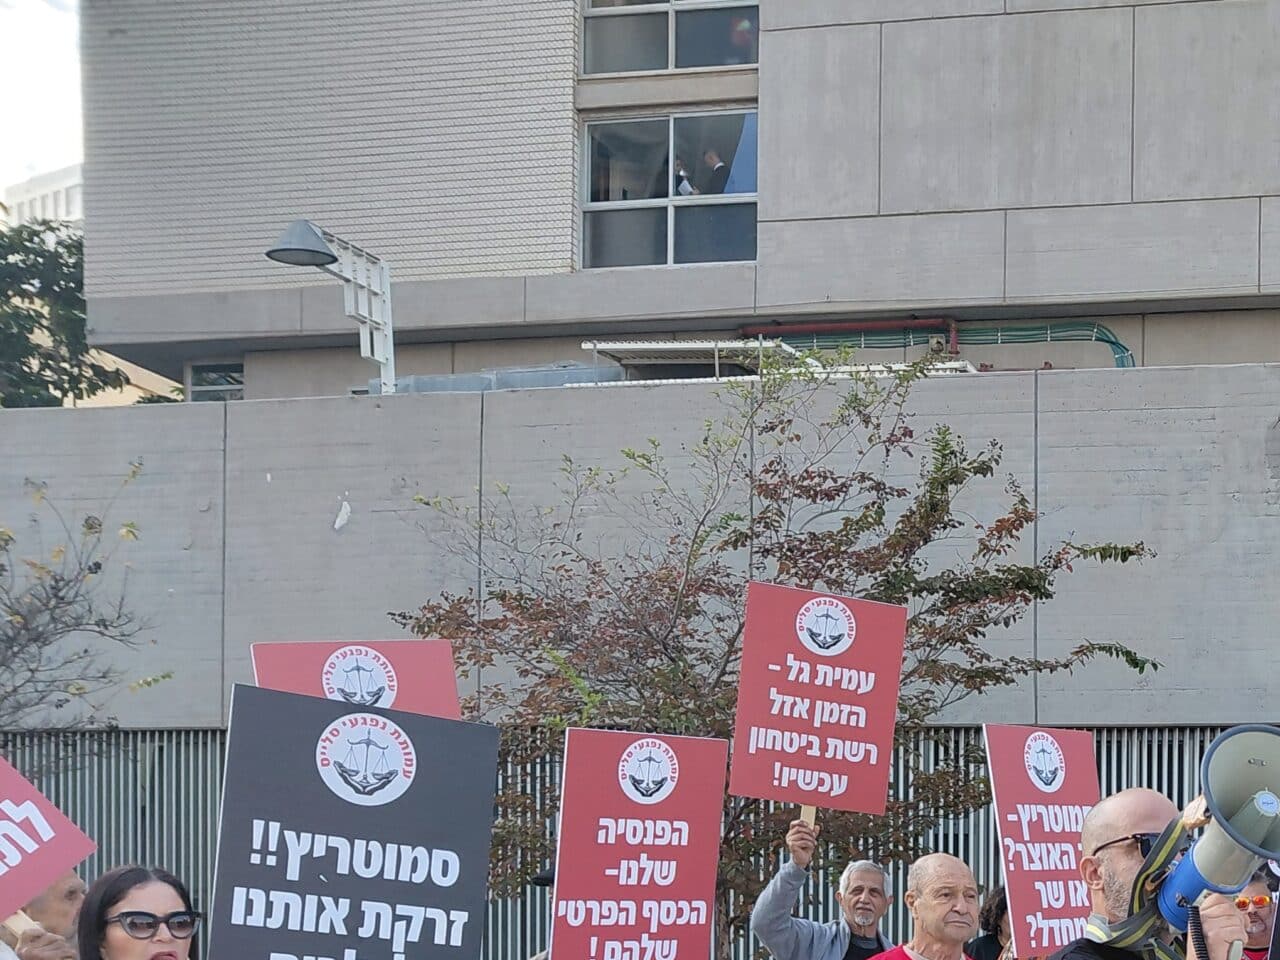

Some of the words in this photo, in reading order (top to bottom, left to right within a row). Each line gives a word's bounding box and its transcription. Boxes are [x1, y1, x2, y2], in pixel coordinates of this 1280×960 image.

[786, 653, 811, 684] גל
[815, 663, 876, 695] עמית
[769, 687, 810, 719] אזל
[813, 699, 867, 728] הזמן
[342, 716, 388, 731] נפגעי
[320, 727, 342, 768] סלייס
[389, 726, 415, 780] עמותת
[749, 726, 821, 758] ביטחון
[825, 737, 878, 765] רשת
[773, 761, 848, 797] עכשיו!
[0, 799, 56, 876] לת
[597, 818, 689, 846] הפנסיה
[1007, 804, 1092, 840] מוטריץ-
[250, 819, 461, 888] סמוטריץ!!
[605, 853, 677, 886] שלנו-
[1005, 838, 1076, 871] האוצר?
[1035, 880, 1065, 909] שר
[1069, 880, 1090, 907] או
[231, 886, 350, 936] אותנו
[357, 899, 469, 953] זרקת
[558, 900, 636, 927] הפרטי
[642, 900, 707, 933] הכסף
